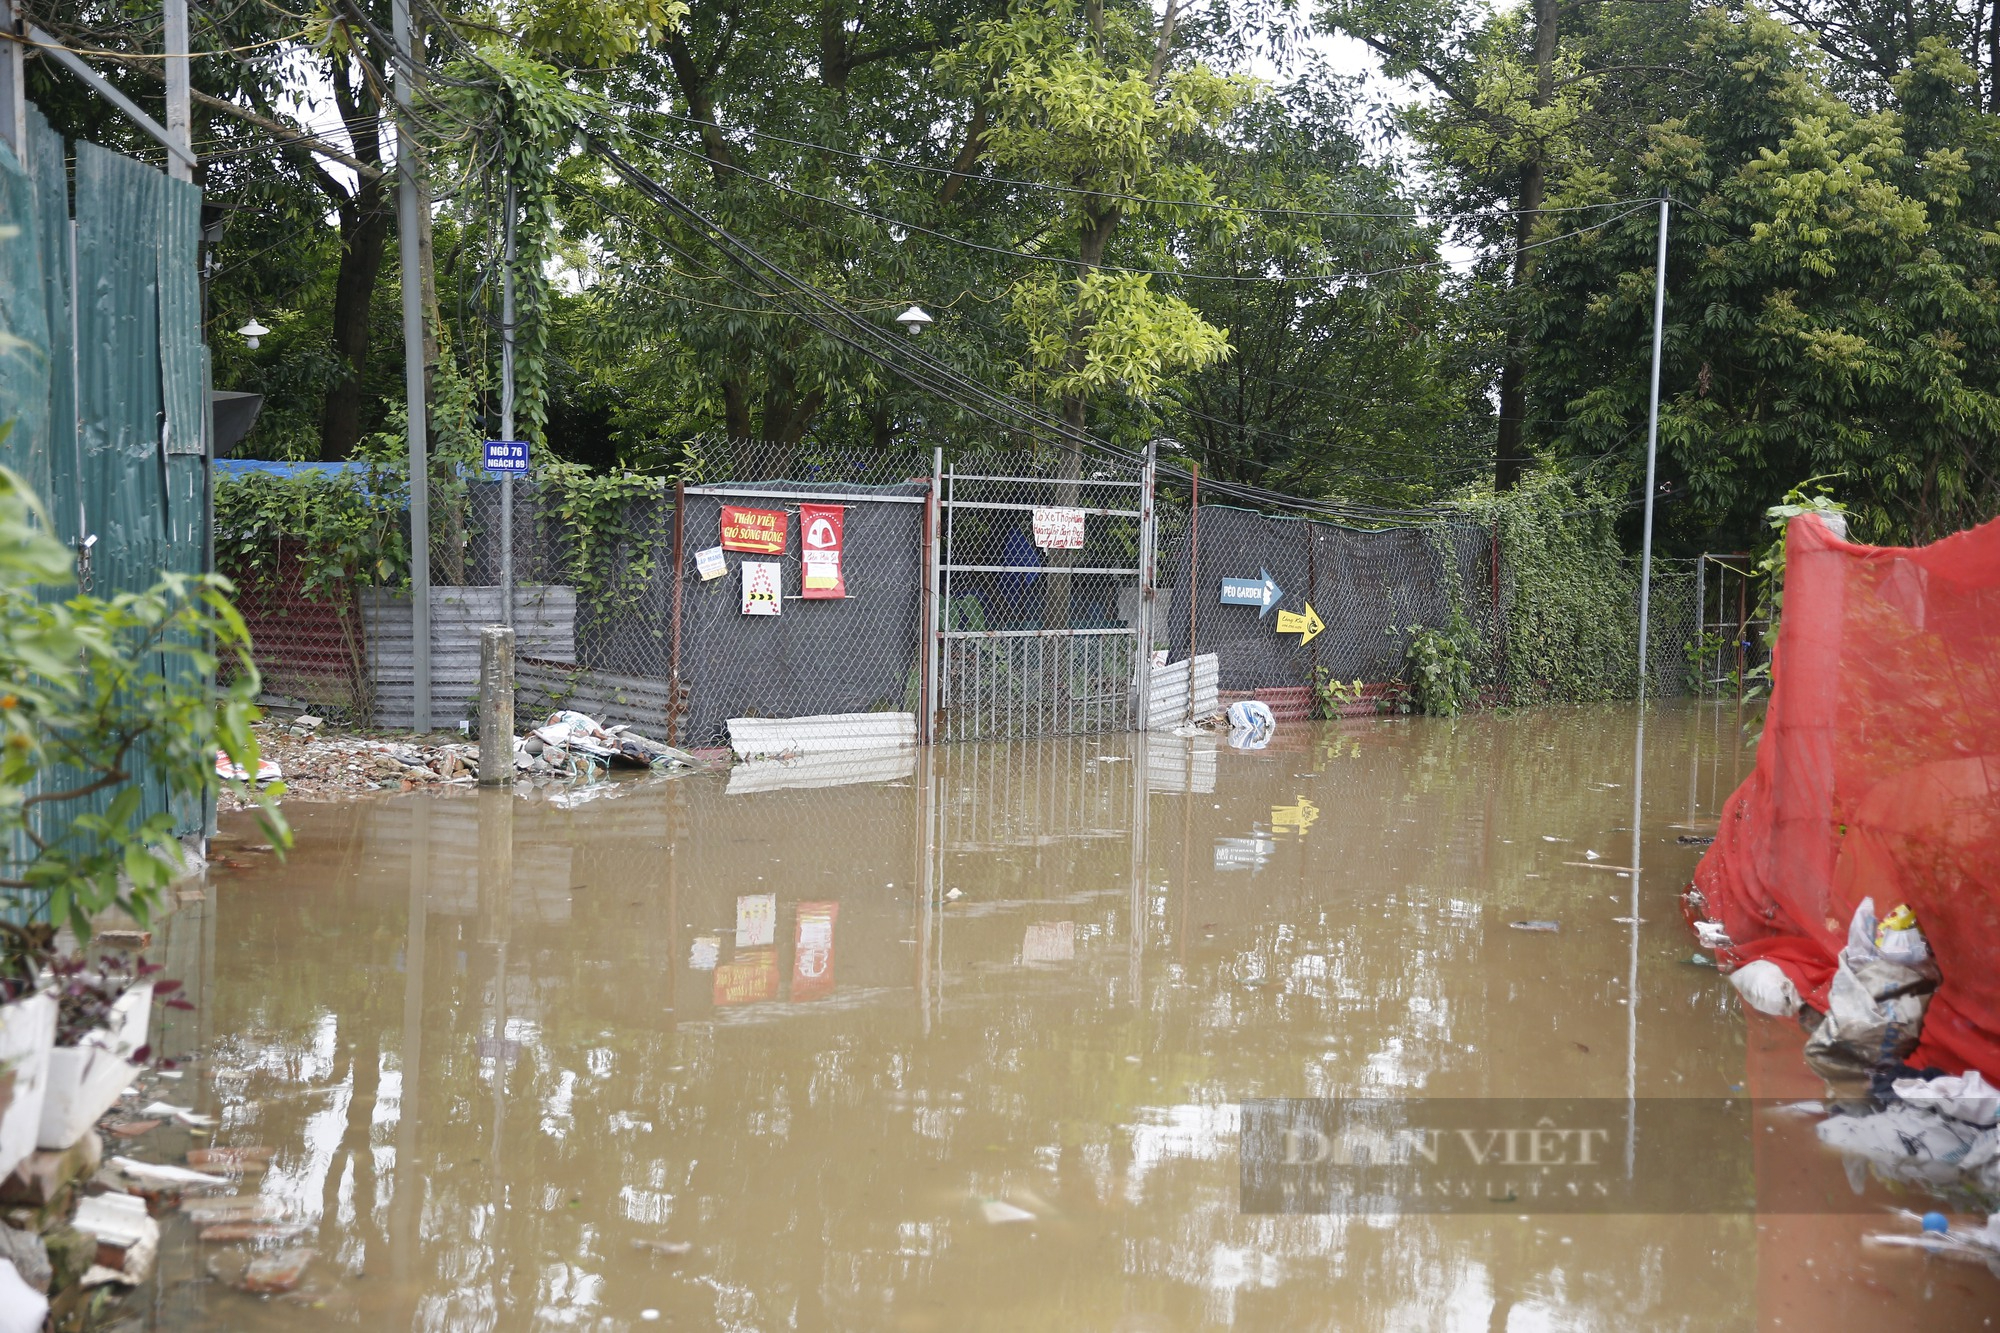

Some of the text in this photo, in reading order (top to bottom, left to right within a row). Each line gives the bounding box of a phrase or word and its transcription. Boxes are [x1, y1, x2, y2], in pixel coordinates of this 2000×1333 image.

[511, 447, 522, 456] 76
[487, 457, 525, 468] NGÁCH 89
[724, 525, 739, 538] GIÓ
[739, 526, 761, 541] SÔNG
[1236, 586, 1263, 599] GARDEN
